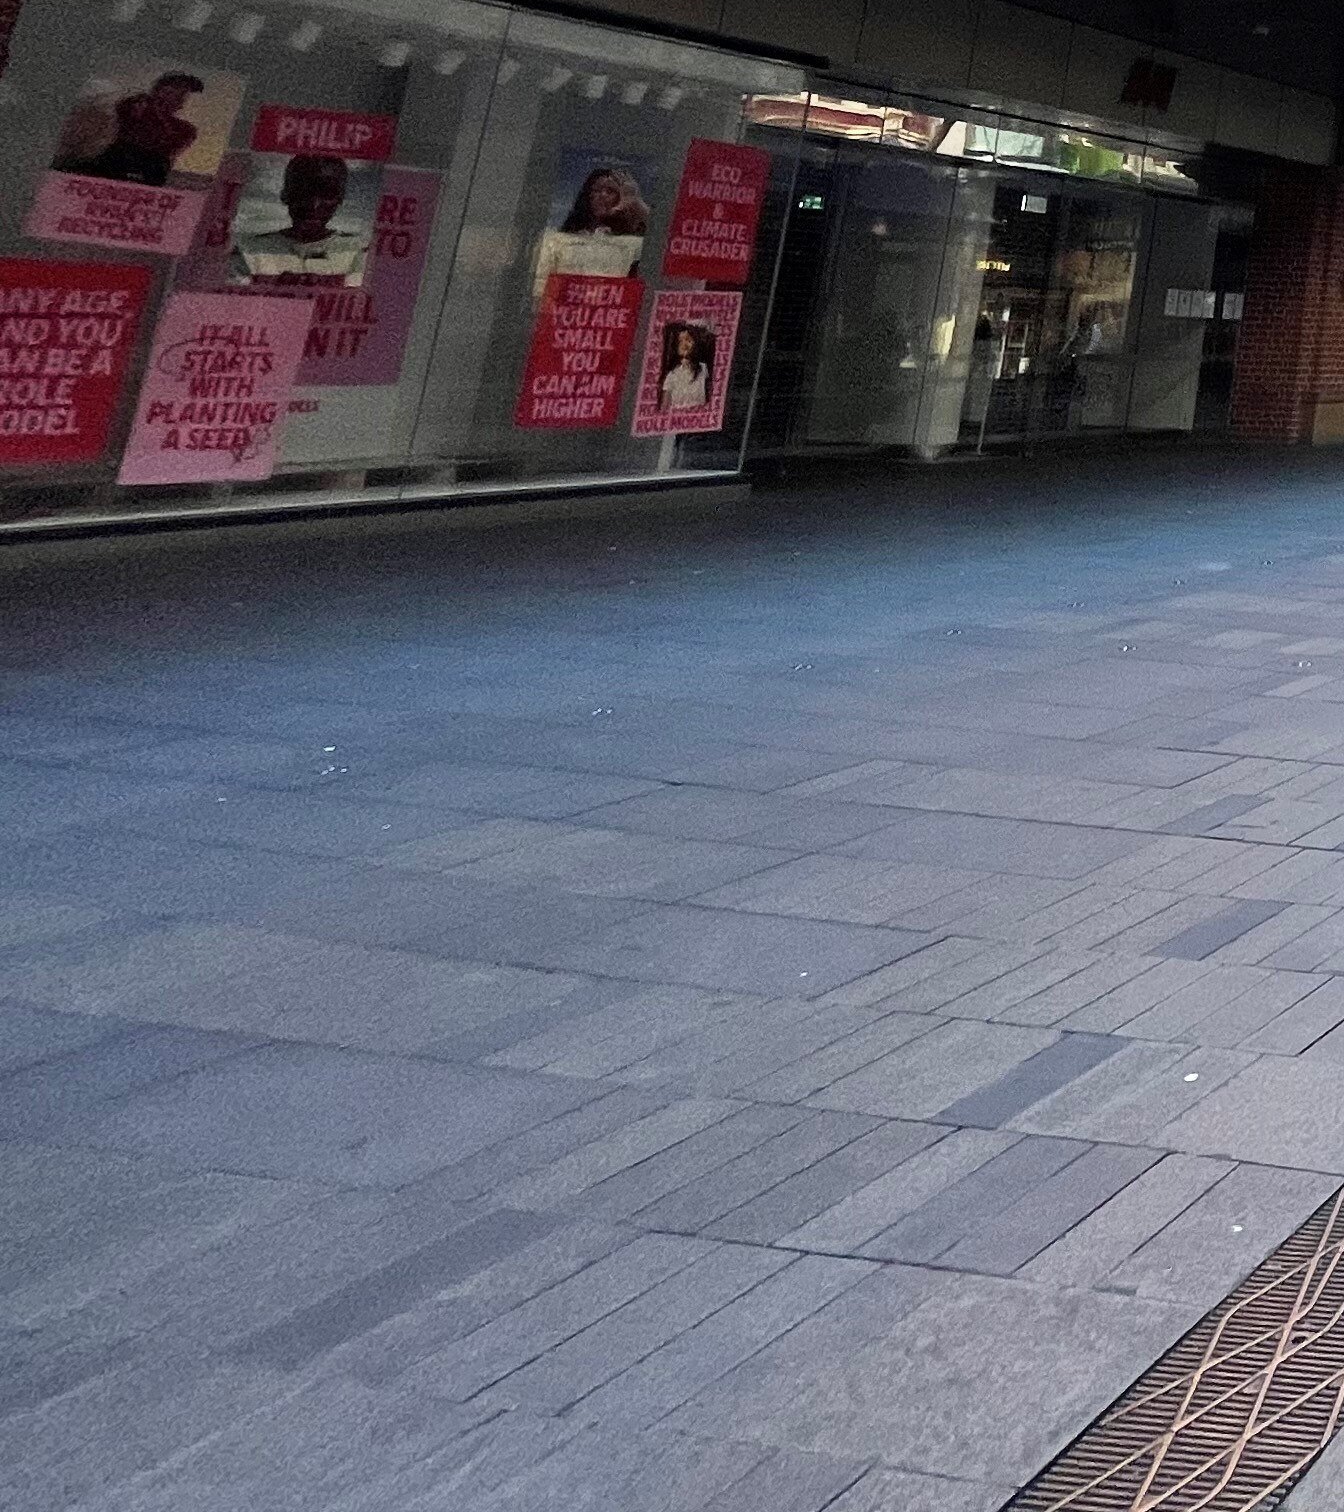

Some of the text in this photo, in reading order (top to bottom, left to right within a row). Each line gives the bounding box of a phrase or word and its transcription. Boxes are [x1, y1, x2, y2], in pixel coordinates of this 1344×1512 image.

[277, 116, 372, 149] PHILIP
[712, 165, 741, 183] ECO
[688, 180, 756, 204] WARRIOR
[682, 219, 748, 241] CLIMATE
[670, 237, 749, 261] CRUSADER
[566, 283, 625, 305] WHEN
[552, 306, 631, 328] YOU ARE
[58, 317, 124, 346] YOU
[552, 329, 615, 350] SMALL
[44, 349, 88, 375] BE
[89, 349, 113, 376] A
[181, 349, 274, 374] STARTS
[561, 351, 601, 372] YOU
[189, 375, 255, 398] WITH
[532, 375, 576, 396] CAN
[146, 400, 278, 424] PLANTING
[532, 397, 605, 420] HIGHER
